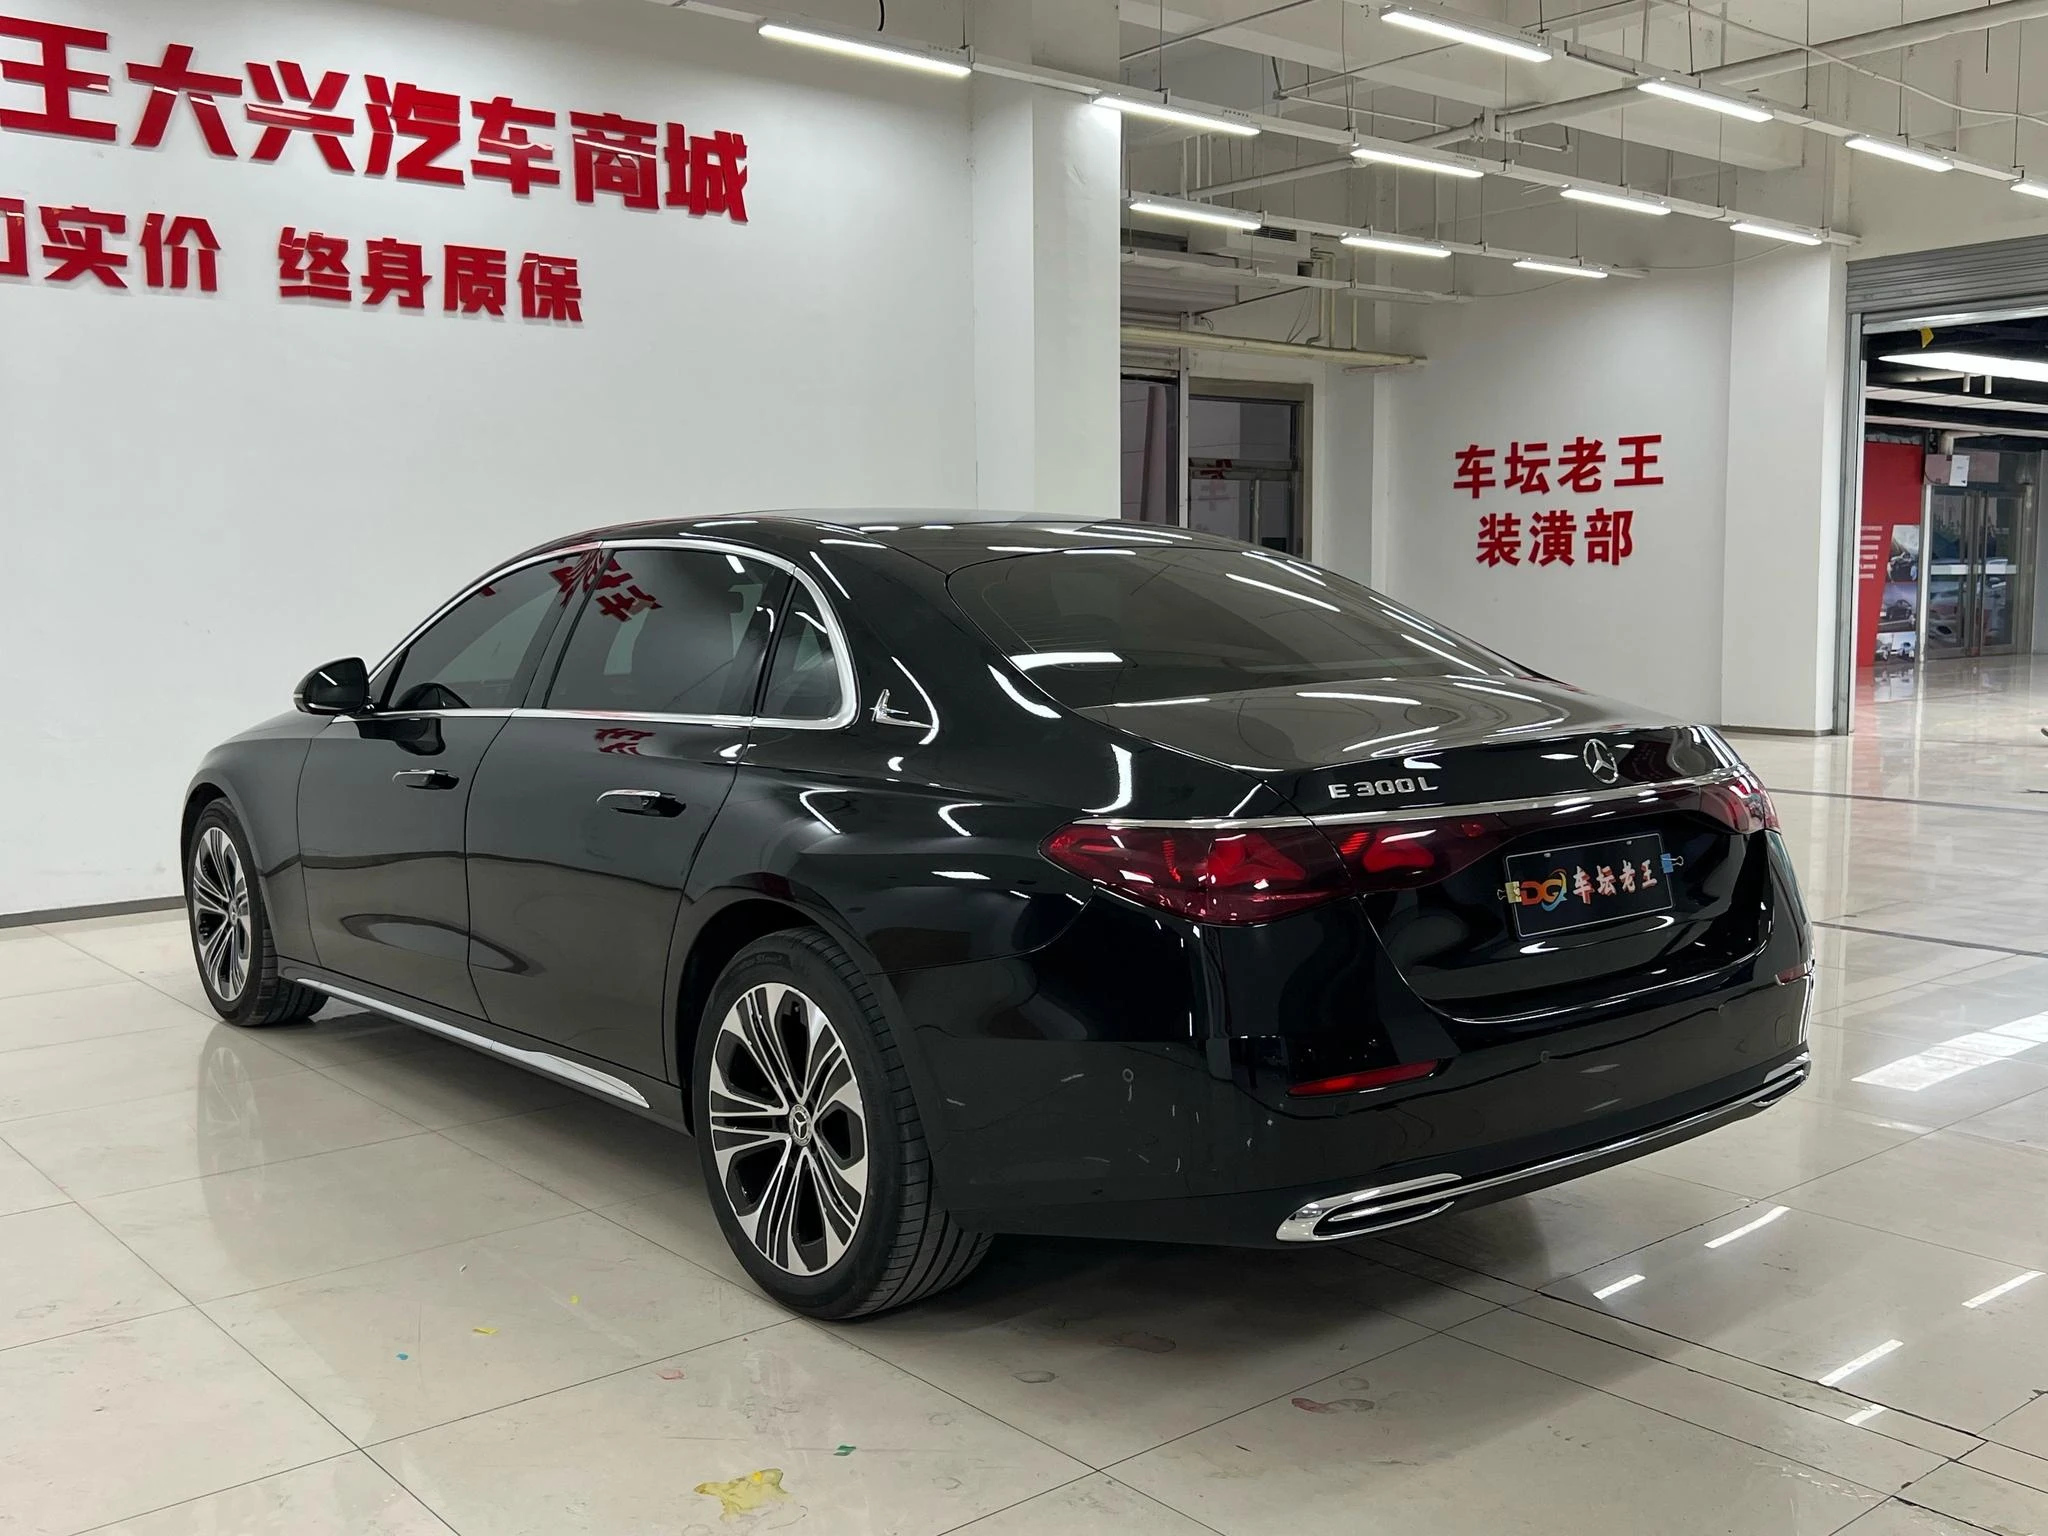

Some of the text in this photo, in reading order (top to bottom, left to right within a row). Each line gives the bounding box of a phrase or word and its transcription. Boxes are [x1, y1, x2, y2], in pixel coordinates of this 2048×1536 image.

[278, 226, 583, 322] 终身质保
[1453, 434, 1664, 499] 车坛老王
[1476, 507, 1634, 567] 装潢部
[1572, 859, 1658, 905] 车坛老王
